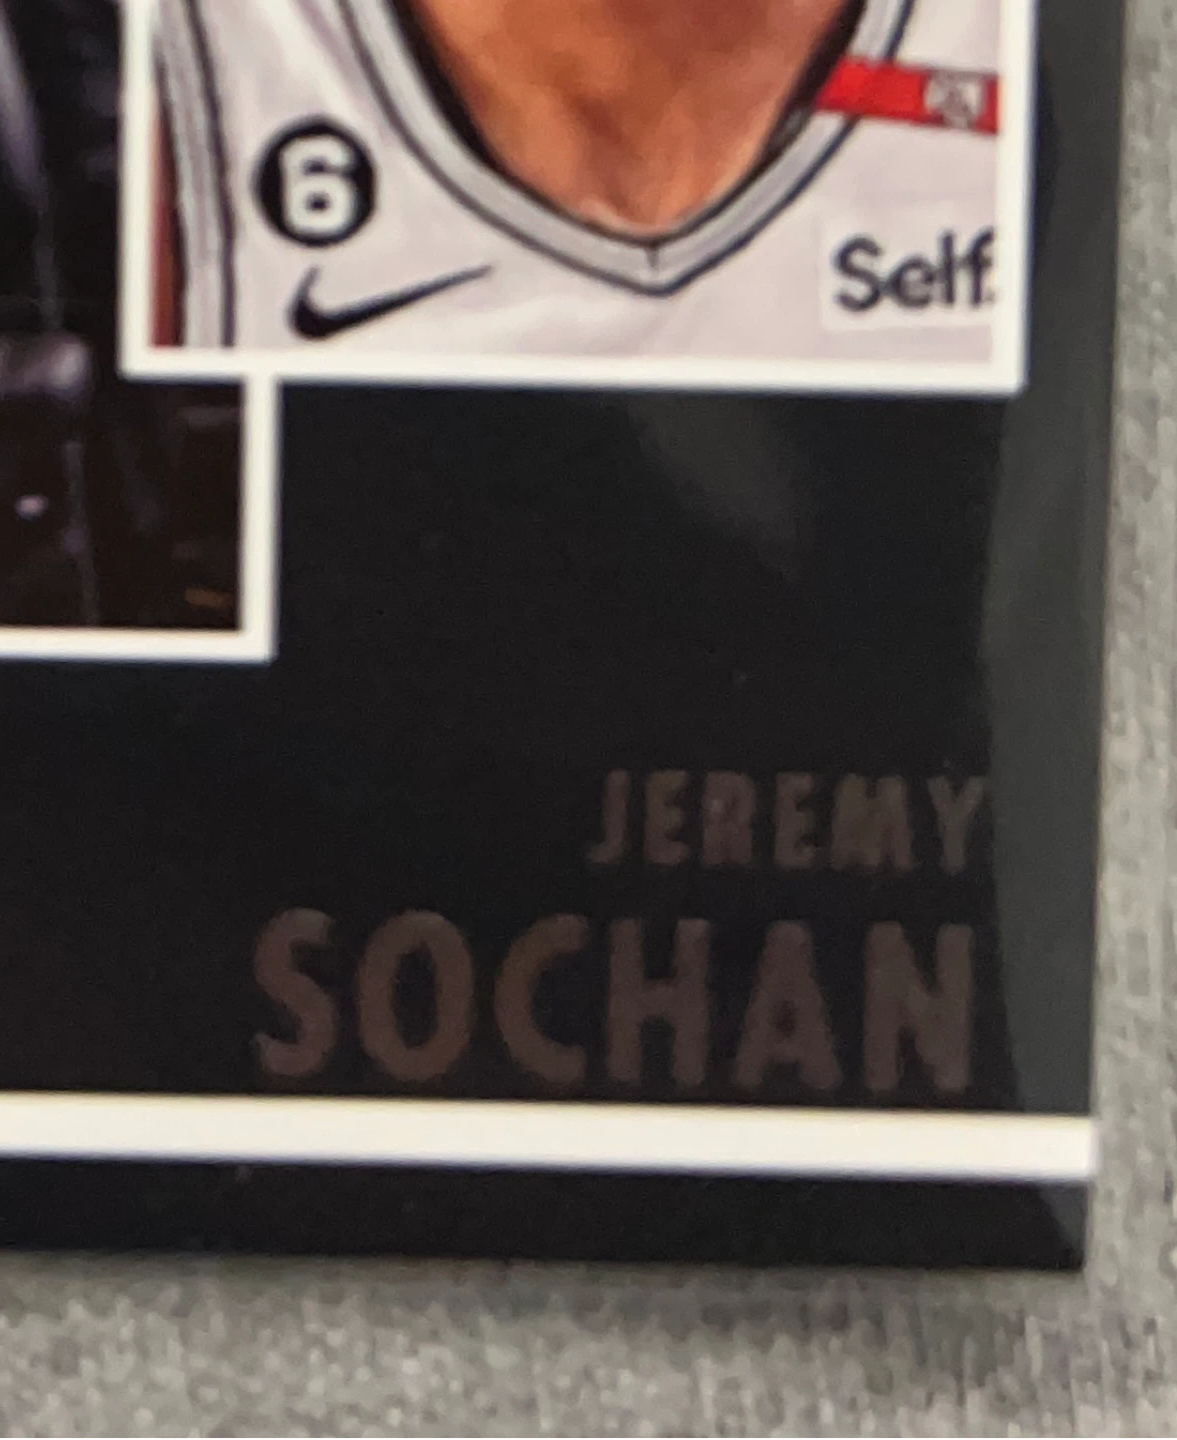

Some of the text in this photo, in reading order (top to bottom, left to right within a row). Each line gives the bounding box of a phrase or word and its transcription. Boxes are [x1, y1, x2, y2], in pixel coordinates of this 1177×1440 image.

[277, 140, 355, 236] 6
[586, 768, 985, 872] JEREMY
[252, 908, 974, 1092] SOCHAN
